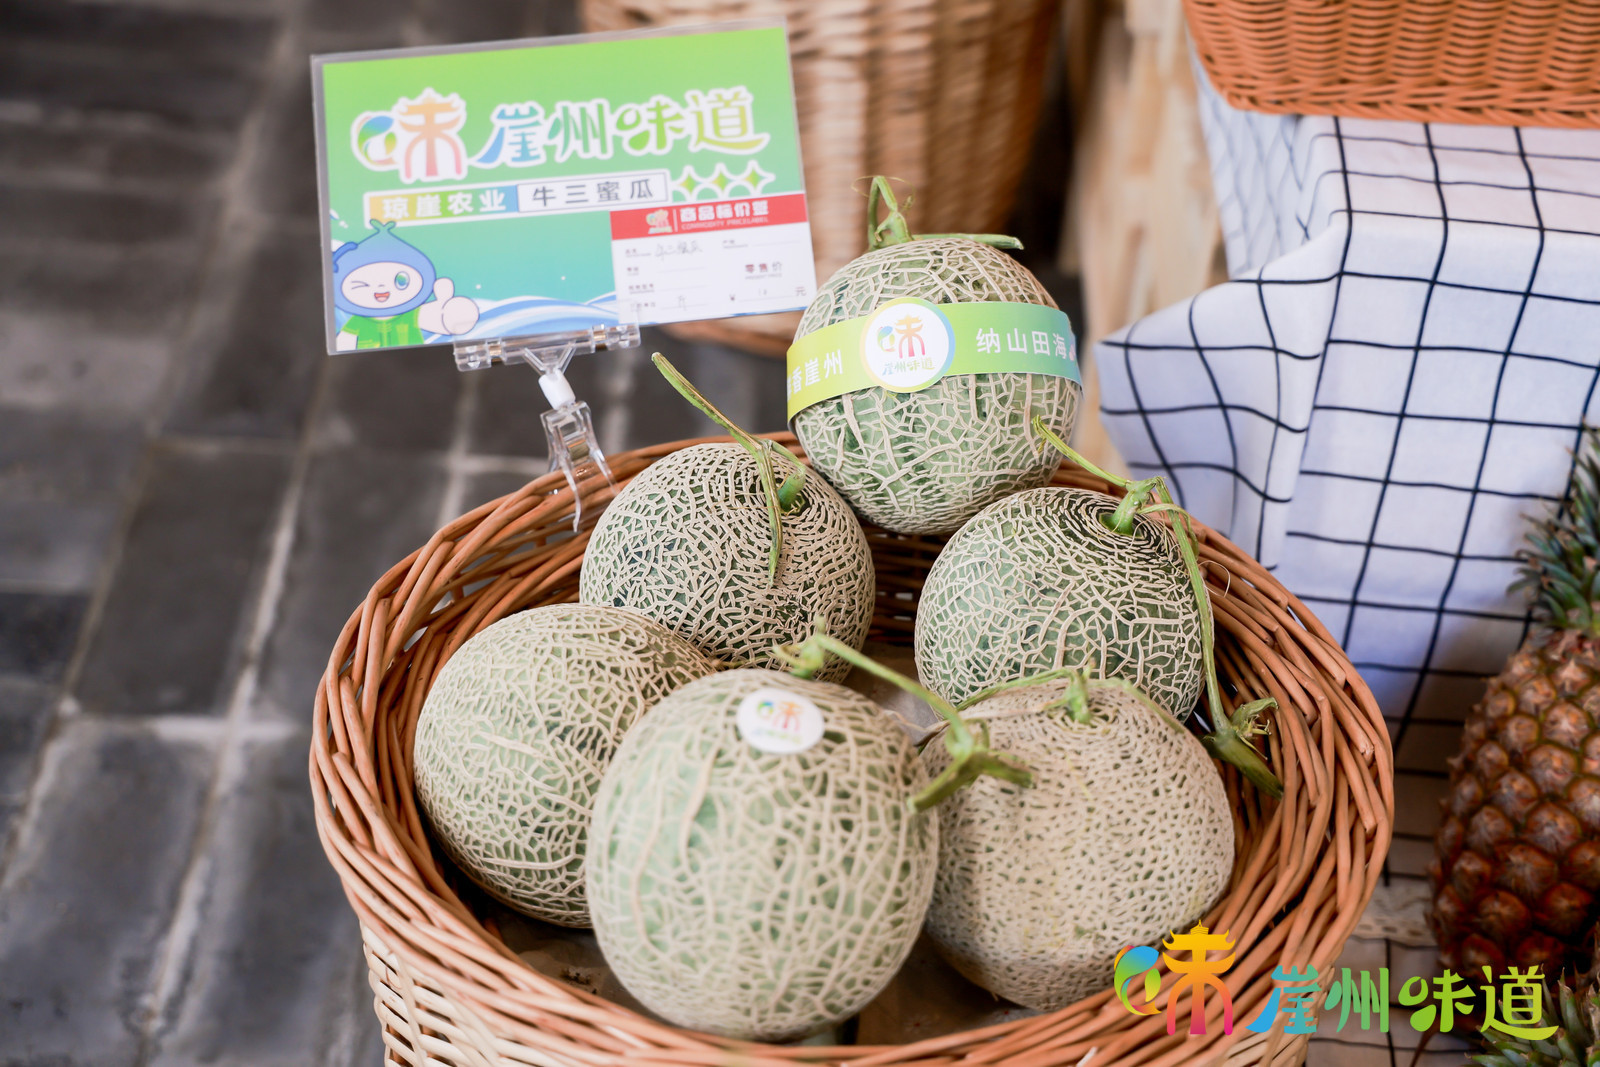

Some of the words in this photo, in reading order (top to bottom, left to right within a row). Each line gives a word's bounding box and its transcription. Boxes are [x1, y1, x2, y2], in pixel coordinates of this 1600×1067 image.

[474, 88, 768, 167] 崖州味道
[382, 187, 507, 220] 琼崖农业
[532, 176, 654, 207] 牛三蜜瓜
[745, 261, 783, 275] 零售价
[795, 285, 807, 297] 元
[976, 327, 1067, 360] 纳山田海
[882, 357, 936, 377] 崖州味道
